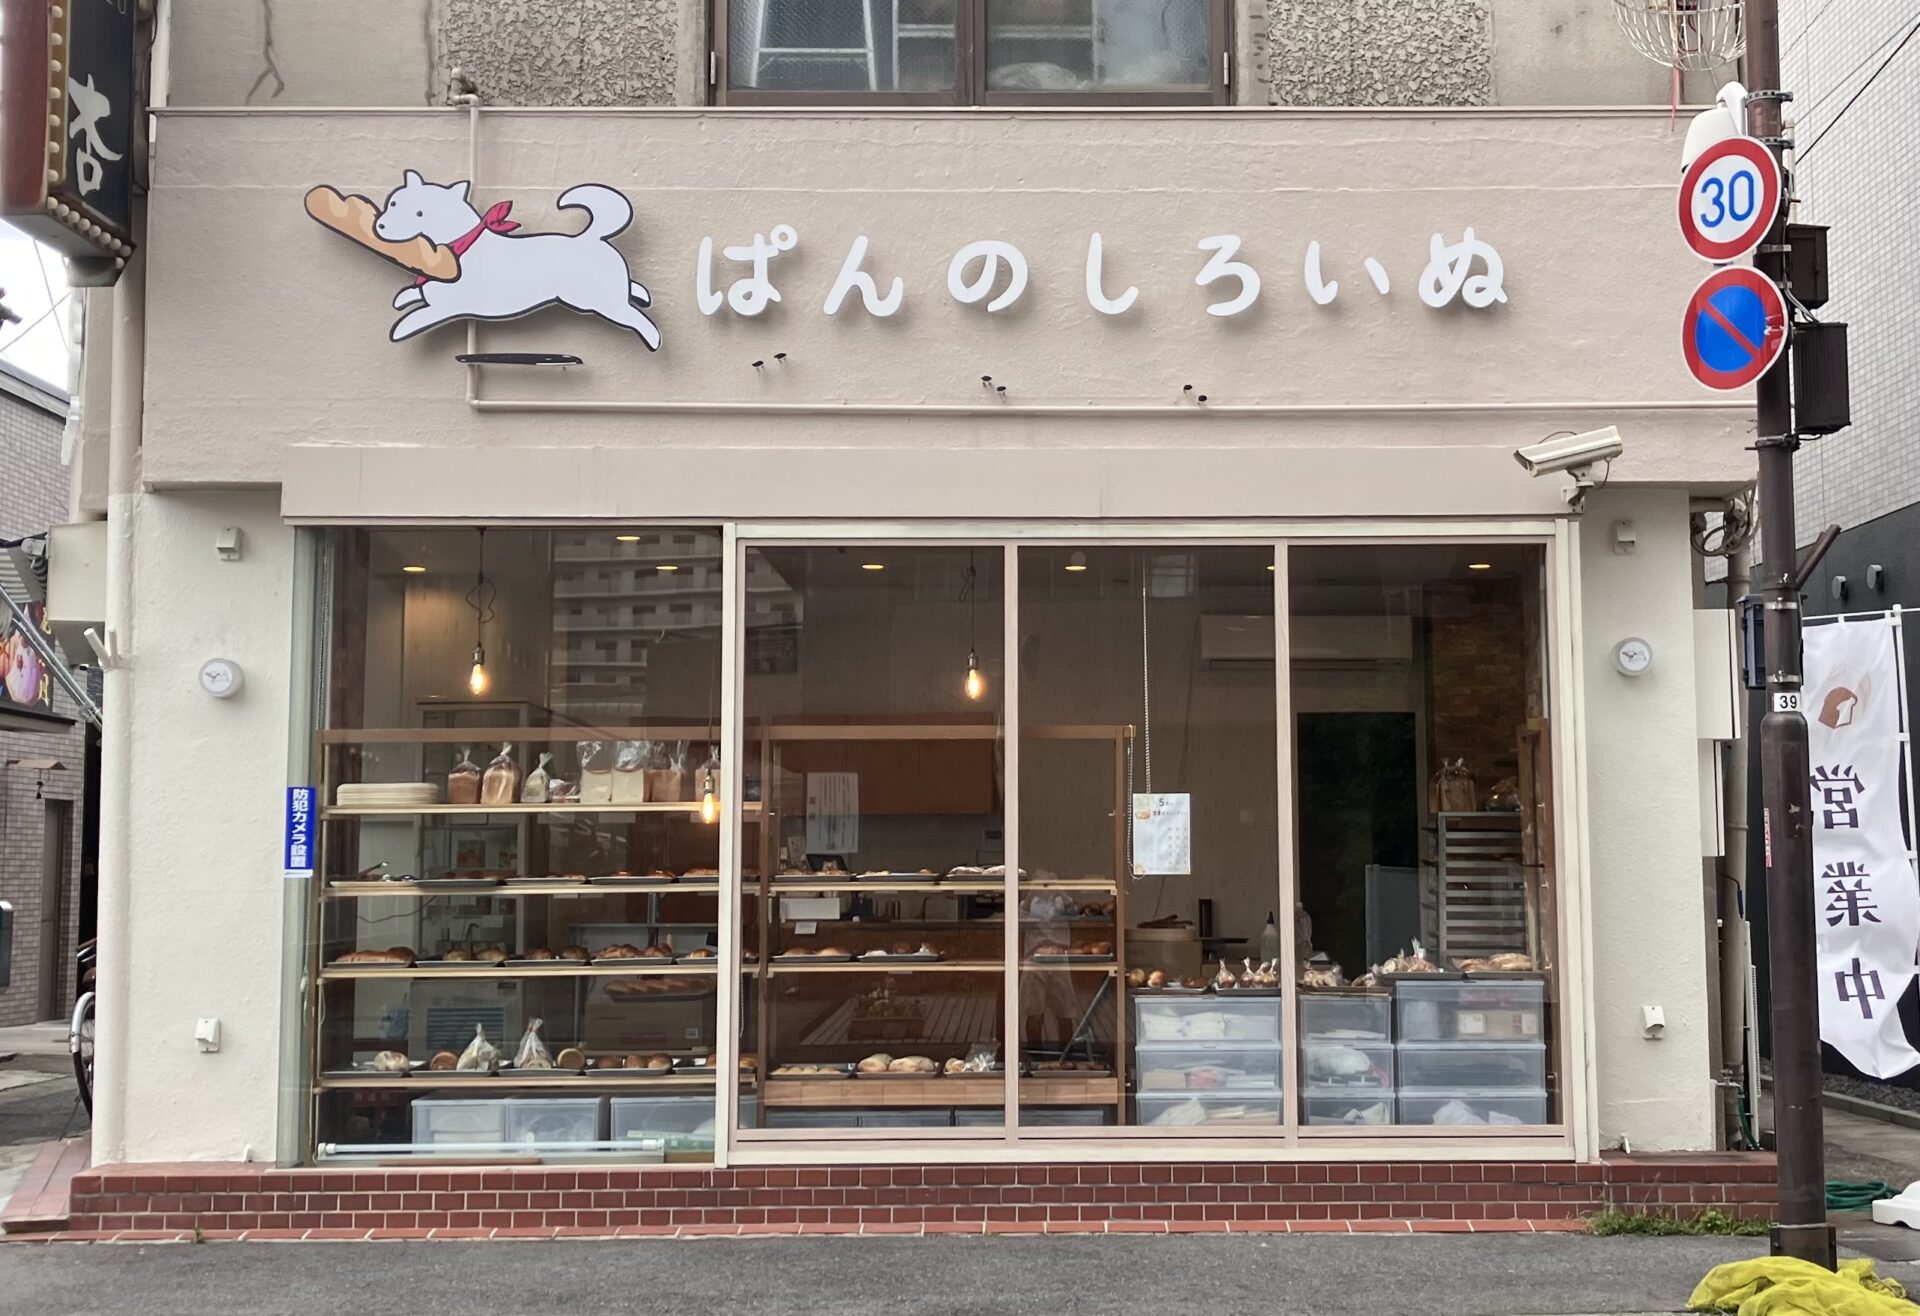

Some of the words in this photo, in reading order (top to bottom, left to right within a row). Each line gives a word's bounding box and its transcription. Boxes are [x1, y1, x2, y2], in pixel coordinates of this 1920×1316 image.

[1700, 170, 1755, 228] 30
[696, 224, 1508, 317] ぱんのしろいぬ
[1780, 695, 1797, 709] 39
